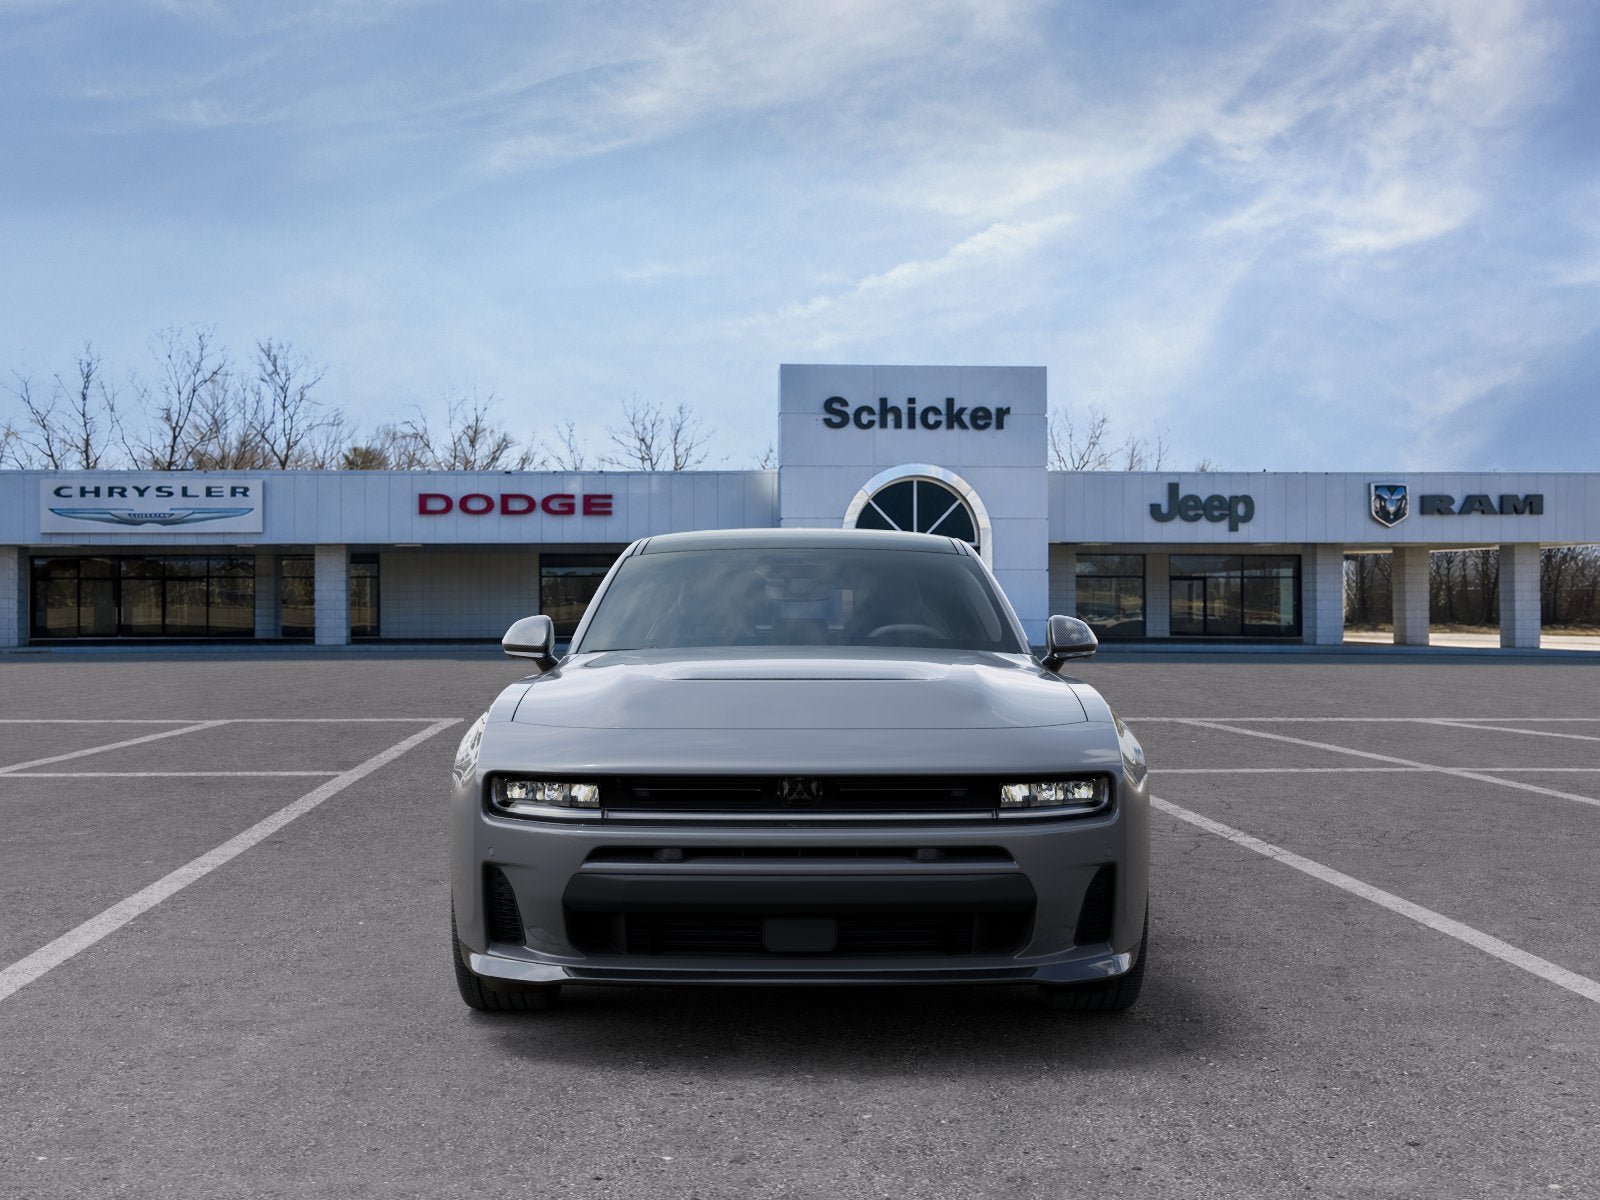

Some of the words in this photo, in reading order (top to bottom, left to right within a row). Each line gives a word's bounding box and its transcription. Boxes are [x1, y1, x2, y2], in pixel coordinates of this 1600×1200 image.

[823, 396, 1010, 430] Schicker
[54, 486, 250, 498] CHRYSLER
[419, 494, 613, 516] DODGE
[1150, 483, 1254, 532] Jeep
[1419, 494, 1544, 515] RAM
